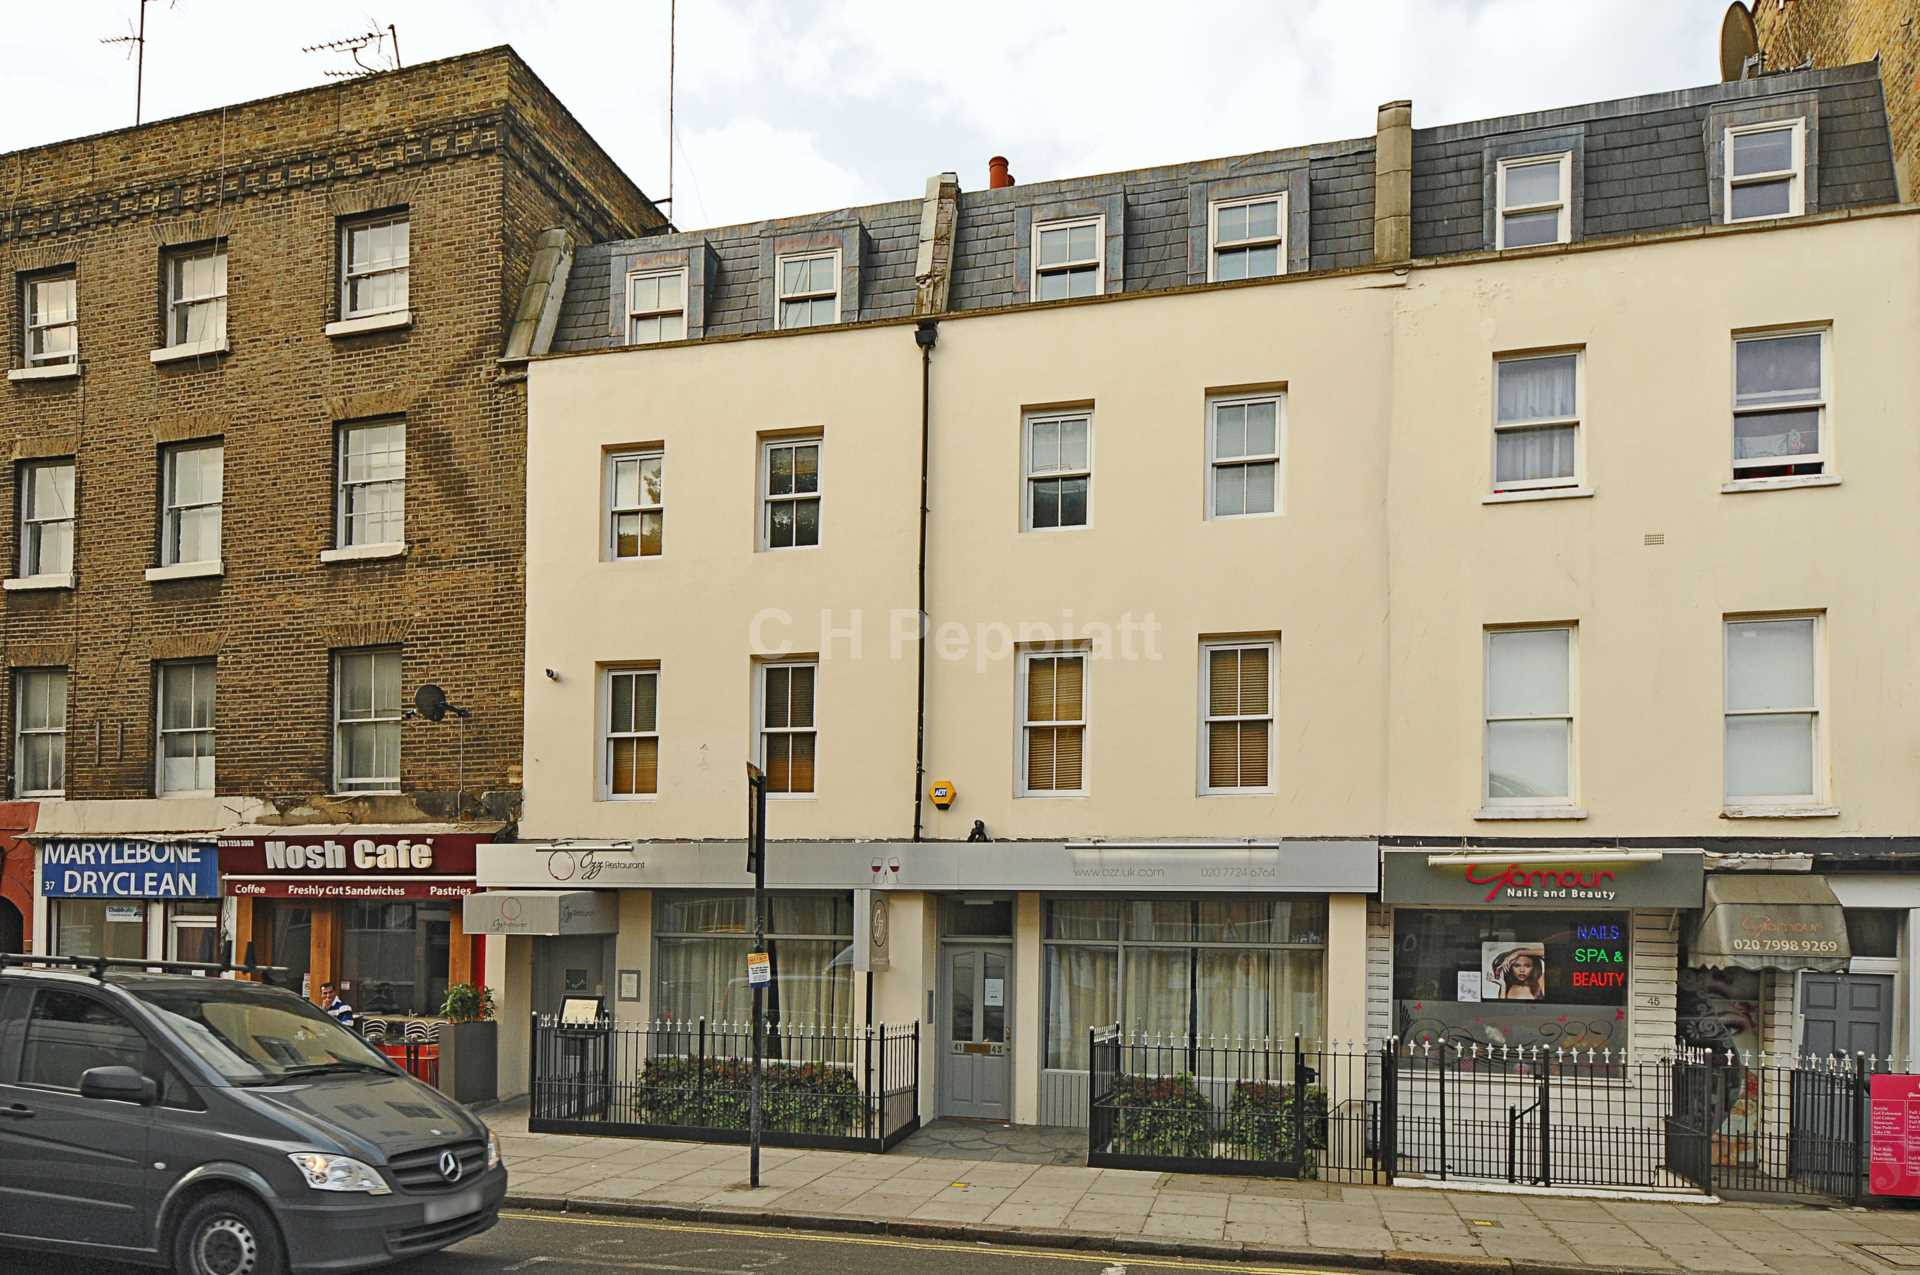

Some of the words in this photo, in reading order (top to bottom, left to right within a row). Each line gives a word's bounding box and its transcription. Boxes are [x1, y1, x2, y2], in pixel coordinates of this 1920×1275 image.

[44, 842, 201, 864] MARYLEBONE
[264, 840, 347, 869] Nosh
[605, 860, 646, 869] Restaurant
[1200, 866, 1220, 878] 020
[1222, 866, 1248, 878] 7724
[44, 881, 56, 890] 37
[63, 870, 197, 896] DRYCLEAN
[234, 884, 266, 894] Coffee
[288, 884, 325, 897] Freshly
[325, 886, 344, 895] Cut
[345, 885, 406, 896] Sandwiches
[429, 885, 472, 896] Pastries
[1506, 888, 1539, 898] Nails
[1543, 888, 1567, 898] and
[1571, 889, 1616, 900] Beauty
[1577, 925, 1620, 940] NAILS
[1733, 939, 1761, 951] 020
[1762, 939, 1799, 951] 7998
[1801, 940, 1838, 952] 9269
[1574, 948, 1609, 963] SPA
[1613, 951, 1624, 962] &
[1572, 972, 1625, 988] BEAUTY
[1648, 997, 1661, 1006] 45
